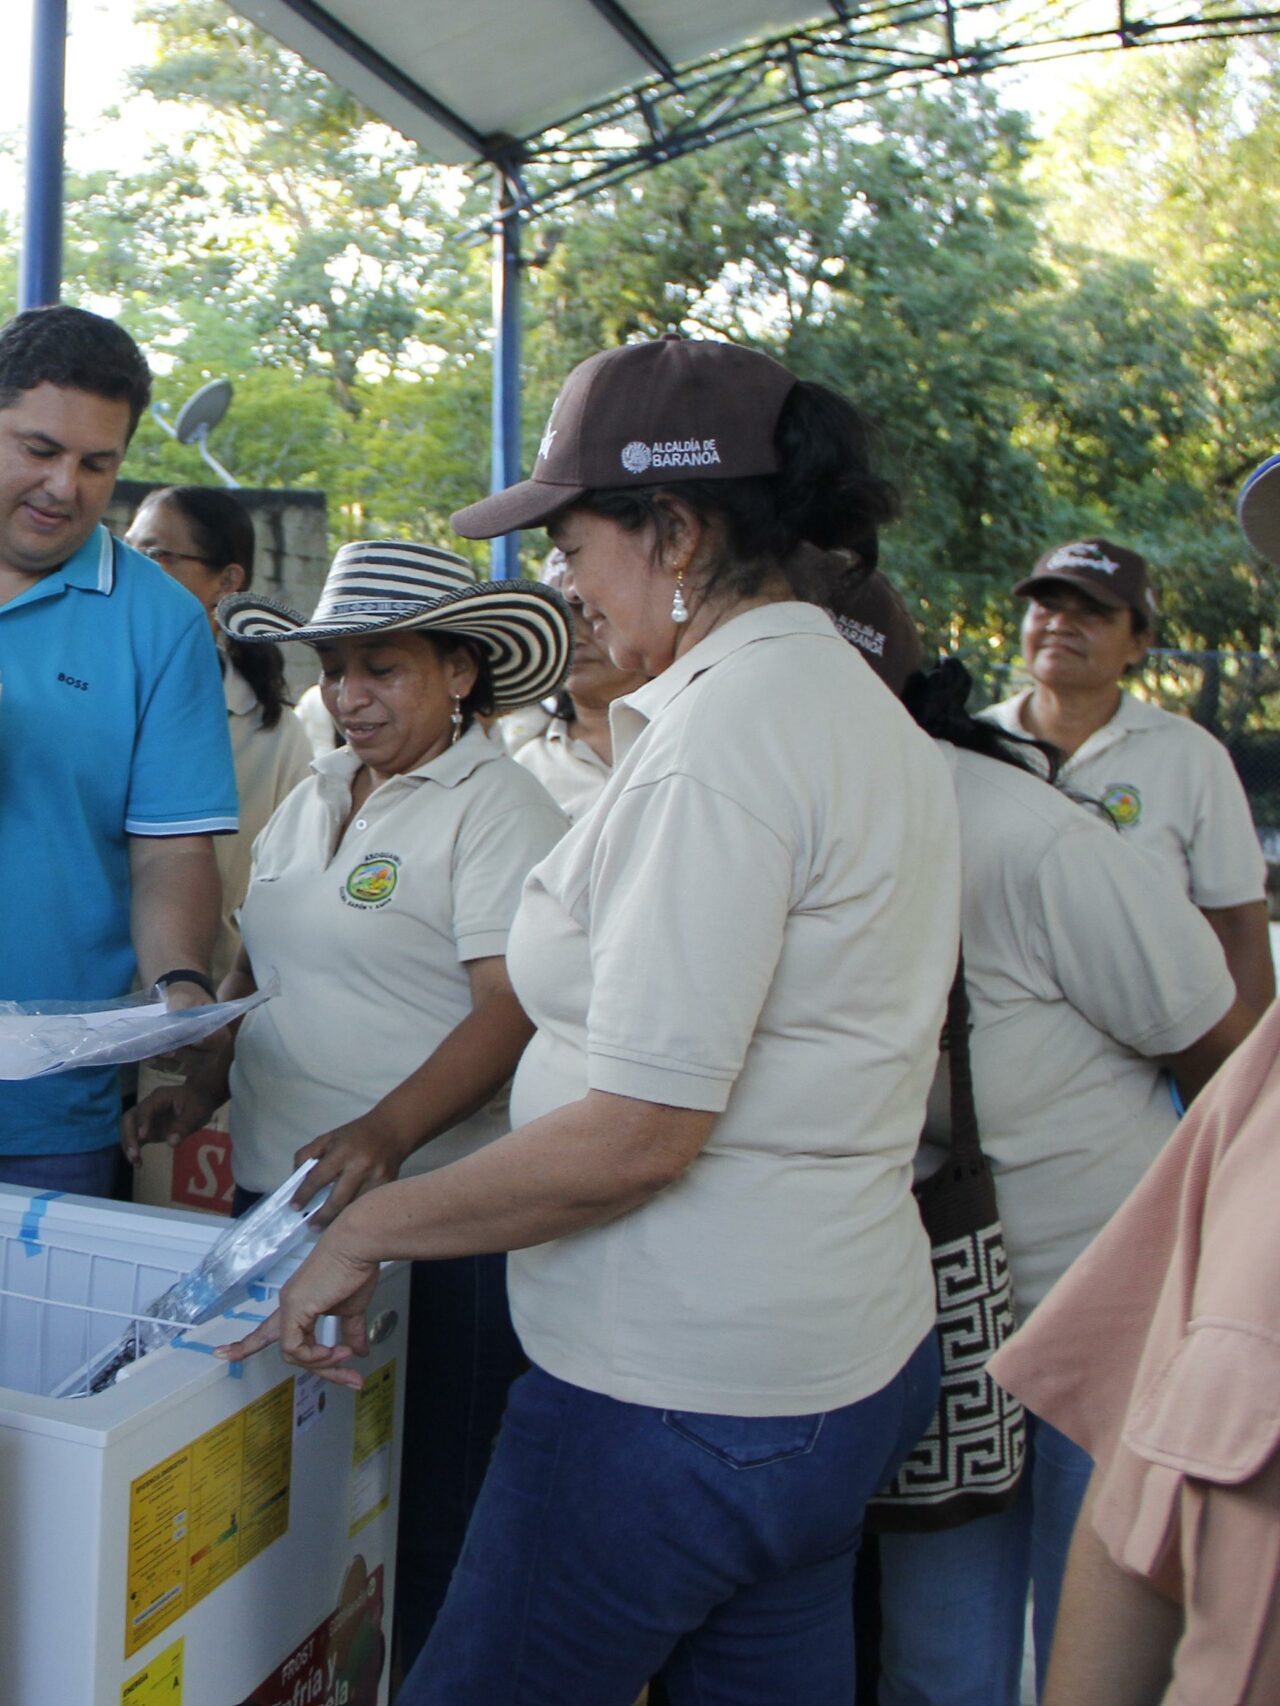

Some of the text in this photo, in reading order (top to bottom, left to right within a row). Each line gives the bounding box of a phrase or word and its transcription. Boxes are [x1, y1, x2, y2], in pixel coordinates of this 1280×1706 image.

[652, 437, 716, 454] ALCALDÍA DE
[652, 451, 721, 468] BARANOA
[57, 671, 89, 691] BOSS
[281, 1637, 315, 1686] FROST
